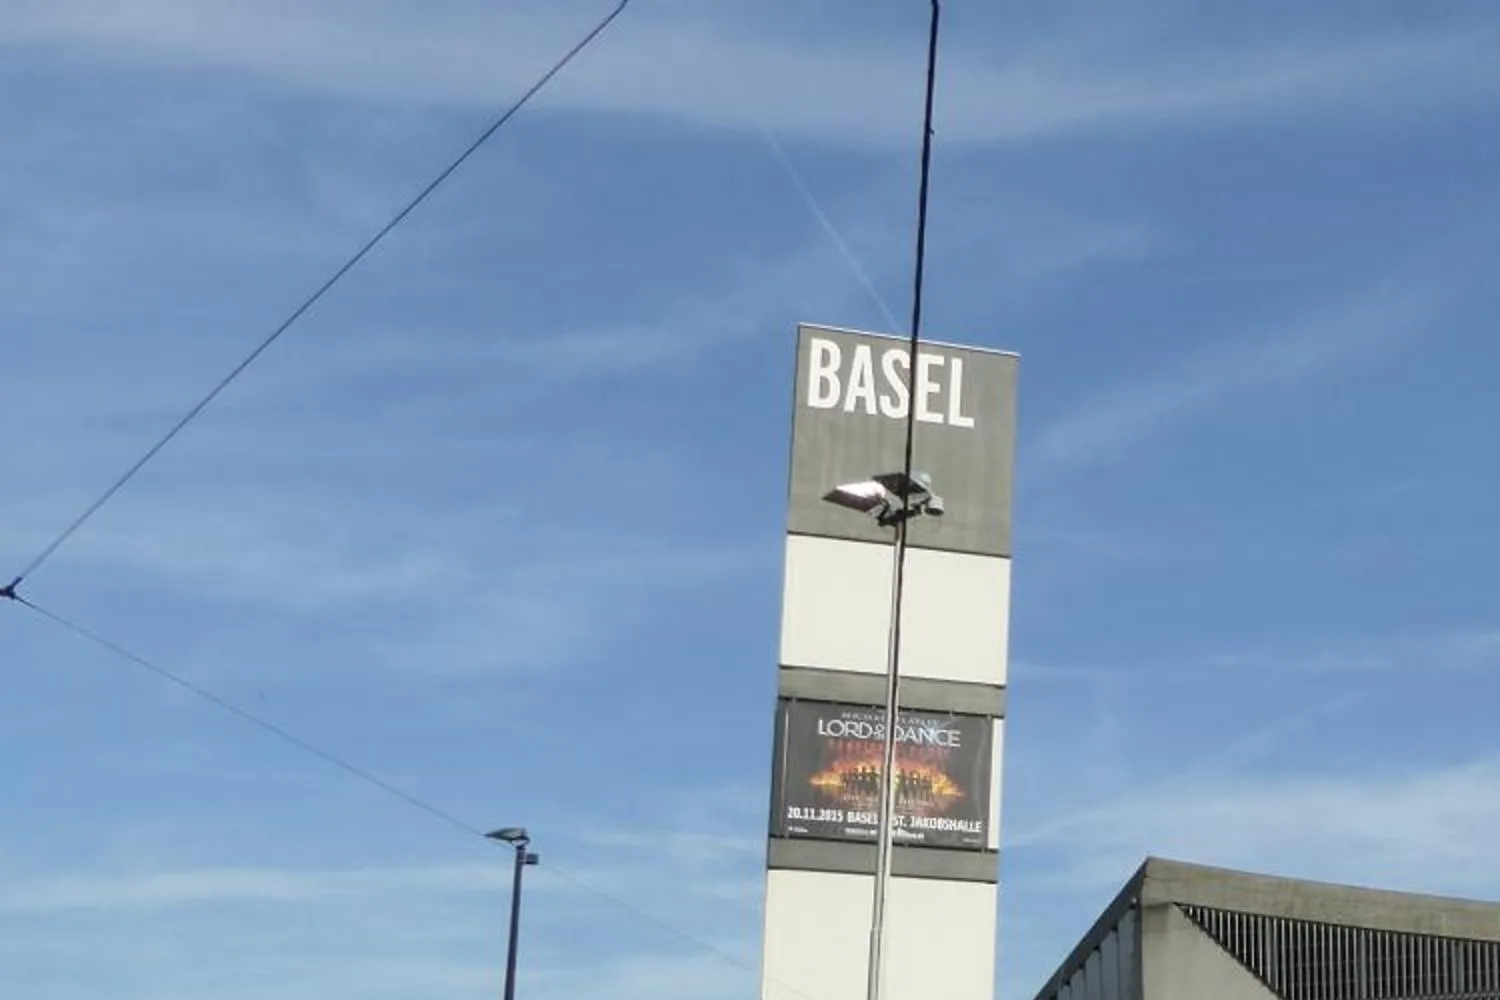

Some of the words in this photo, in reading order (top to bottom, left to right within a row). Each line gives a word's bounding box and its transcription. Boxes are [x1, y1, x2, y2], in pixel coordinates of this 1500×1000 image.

[807, 337, 975, 428] BASEL
[818, 718, 872, 739] LORD
[894, 724, 961, 748] DANCE
